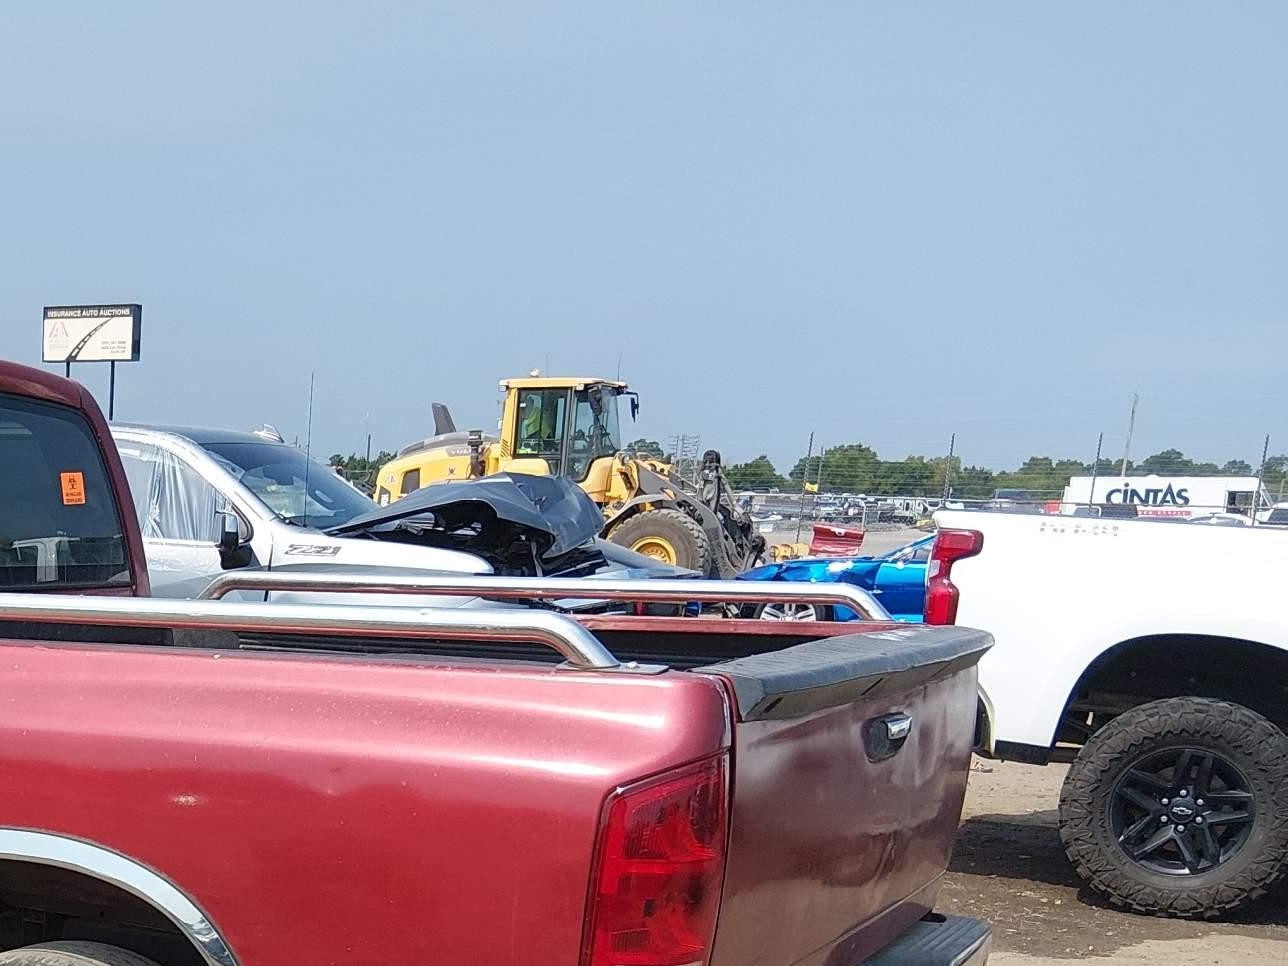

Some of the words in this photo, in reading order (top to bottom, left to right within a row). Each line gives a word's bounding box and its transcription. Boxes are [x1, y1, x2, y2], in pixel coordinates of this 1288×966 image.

[47, 309, 81, 318] INSURANCE
[82, 309, 98, 317] AUTO
[99, 308, 130, 317] AUCTIONS
[284, 543, 342, 557] Z71
